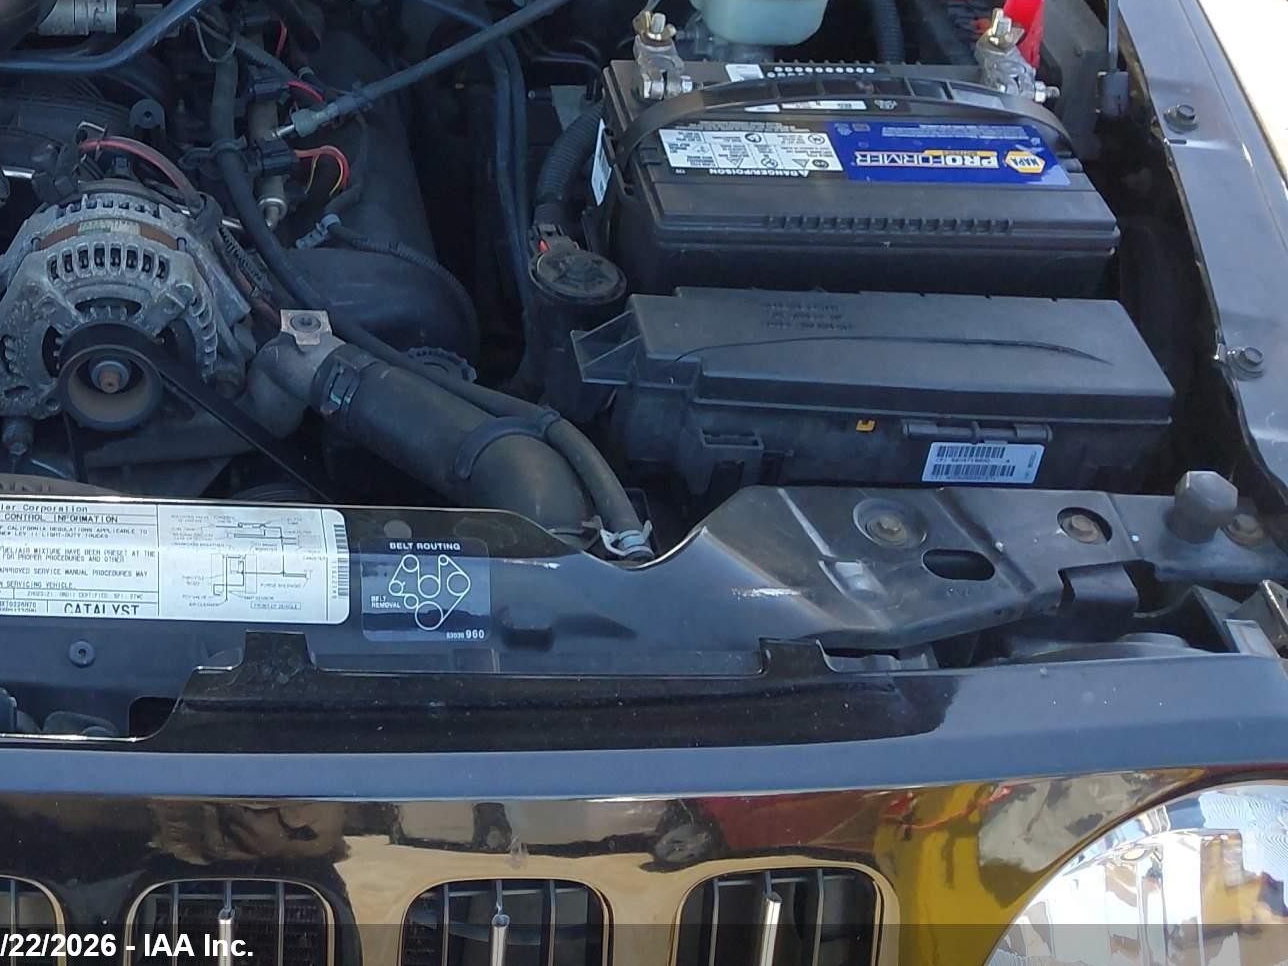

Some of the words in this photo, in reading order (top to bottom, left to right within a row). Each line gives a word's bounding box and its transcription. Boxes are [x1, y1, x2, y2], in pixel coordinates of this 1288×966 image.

[855, 152, 999, 168] PROFORMER
[1009, 157, 1040, 168] NAPA
[23, 503, 88, 513] Corporation
[4, 513, 44, 521] CONTROL
[54, 514, 118, 523] INFORMATION
[389, 542, 413, 550] BELT
[416, 542, 461, 551] ROUTING
[371, 601, 401, 609] REMOVAL
